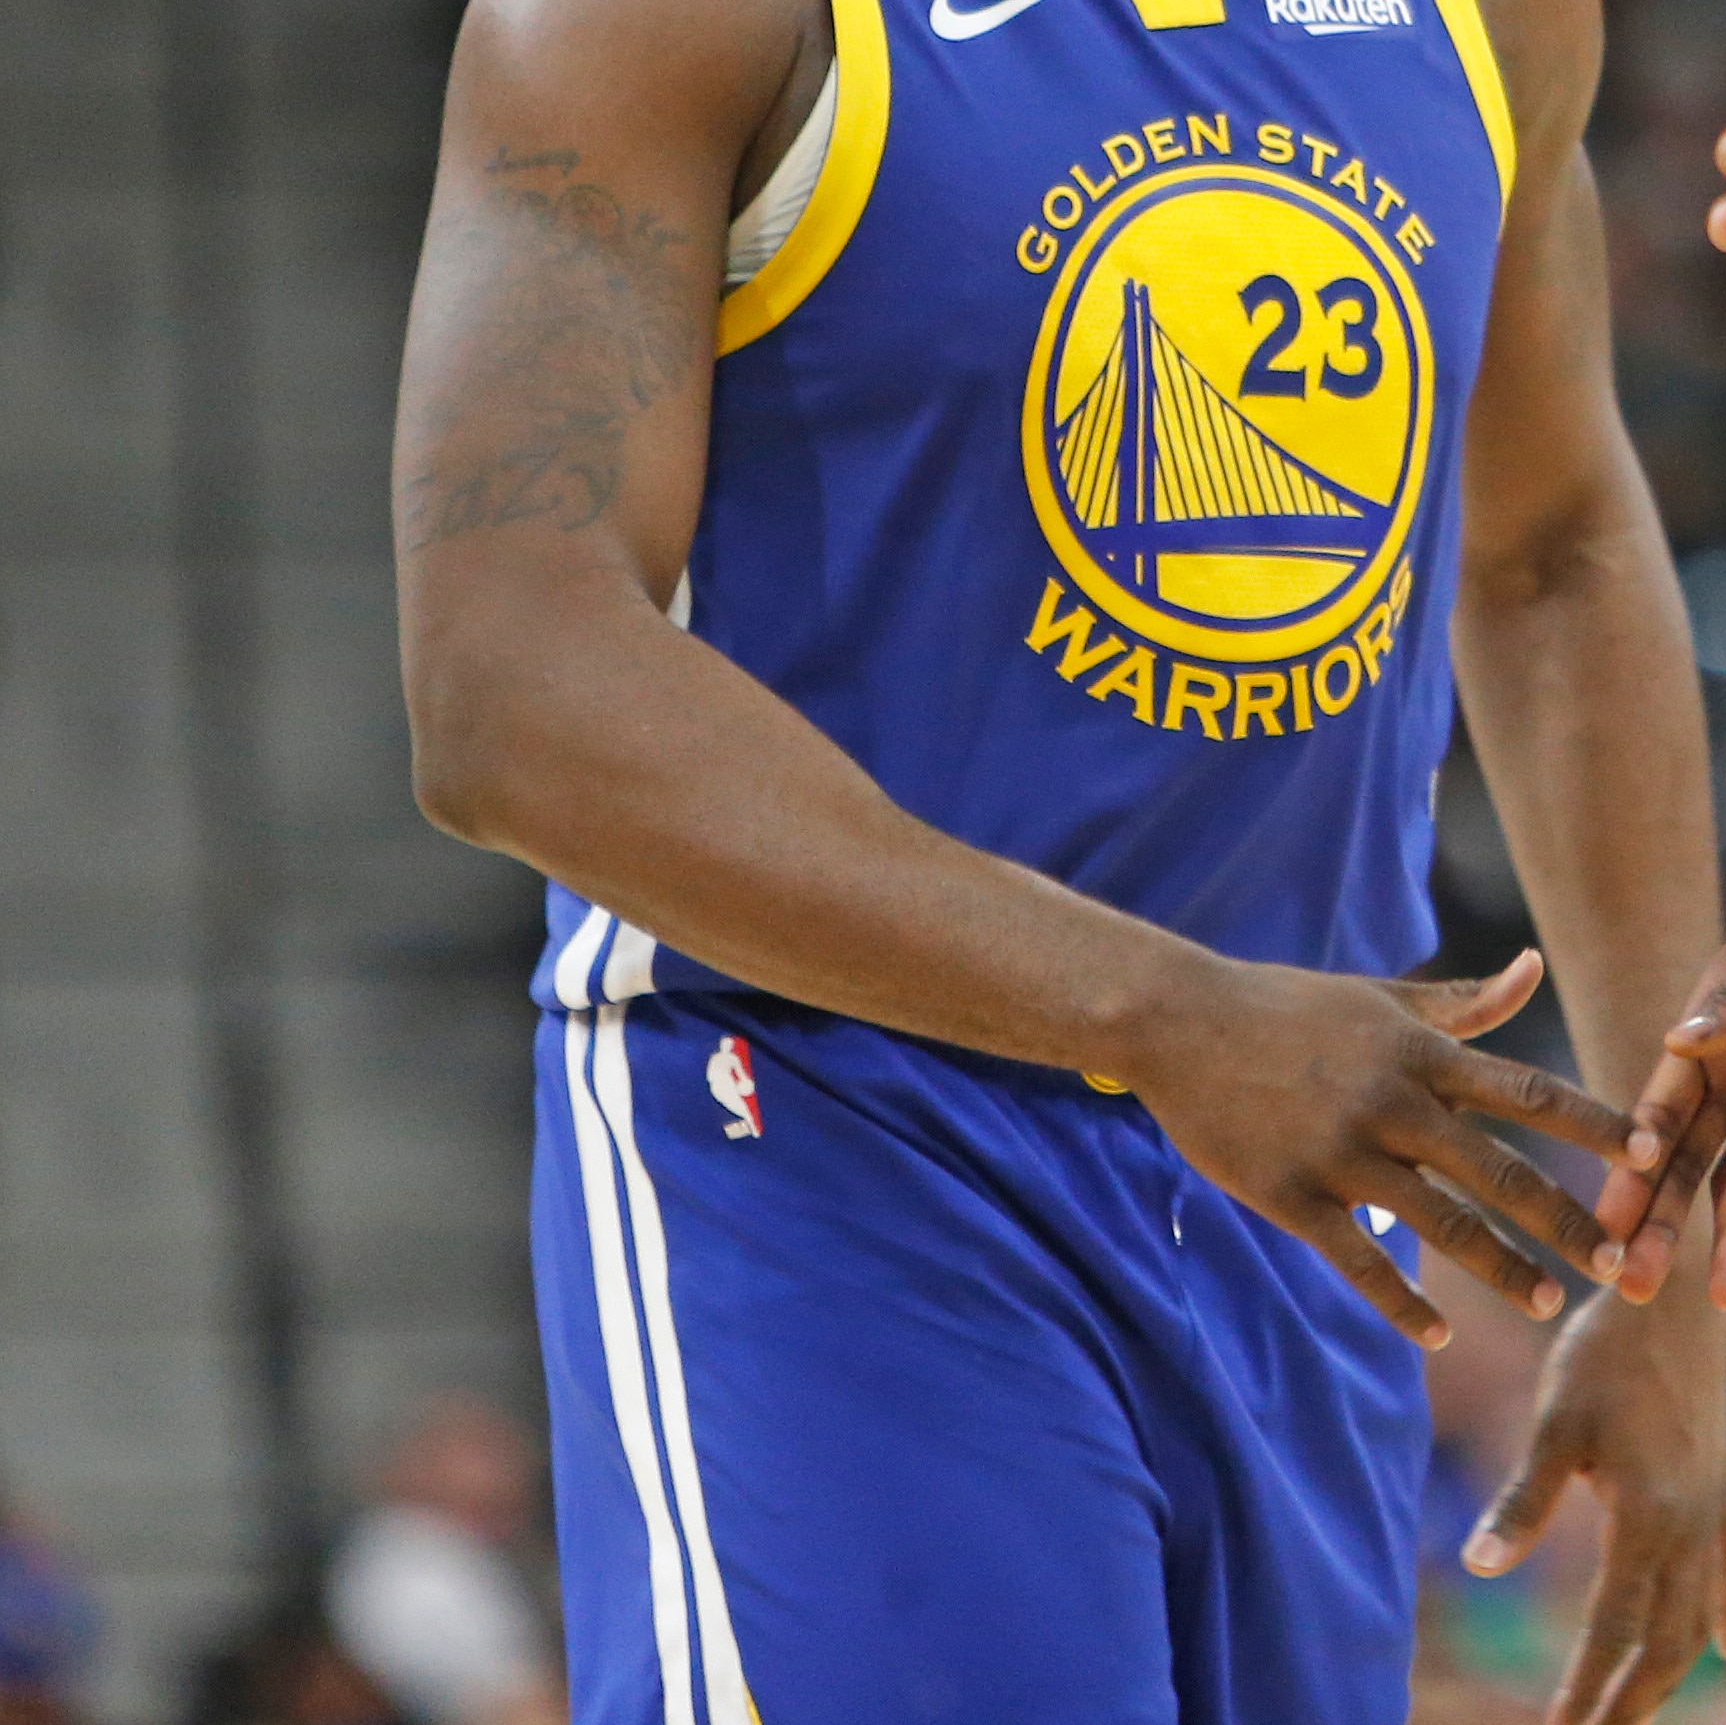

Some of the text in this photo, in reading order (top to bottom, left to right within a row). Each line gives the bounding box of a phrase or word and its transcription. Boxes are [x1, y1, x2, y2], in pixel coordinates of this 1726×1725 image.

[1015, 113, 1436, 274] GOLDEN STATE
[1236, 273, 1383, 400] 23
